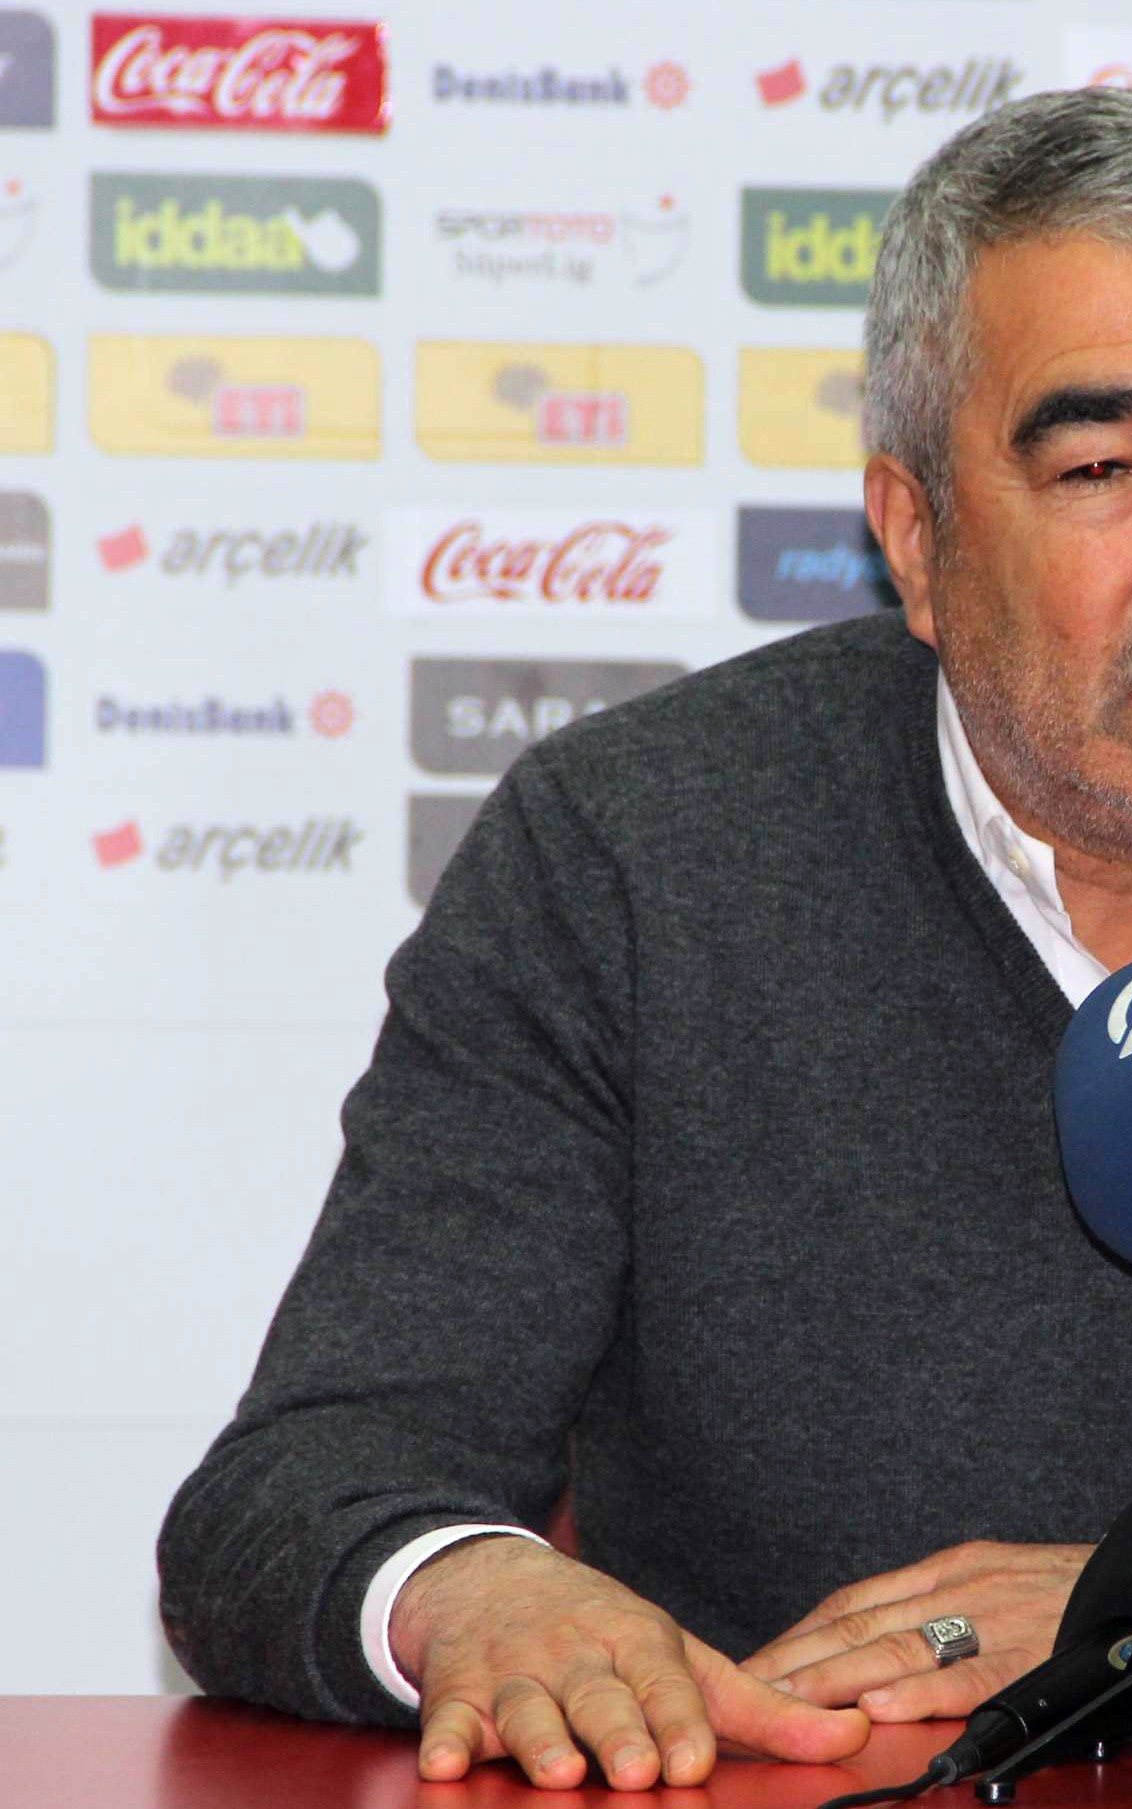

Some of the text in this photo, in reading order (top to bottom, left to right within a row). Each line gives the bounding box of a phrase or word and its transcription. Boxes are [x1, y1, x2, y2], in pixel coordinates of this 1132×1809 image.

[819, 57, 1025, 124] arçelik
[115, 198, 303, 271] iddaa
[163, 522, 368, 587] arçelik
[157, 819, 361, 882] arçelik
